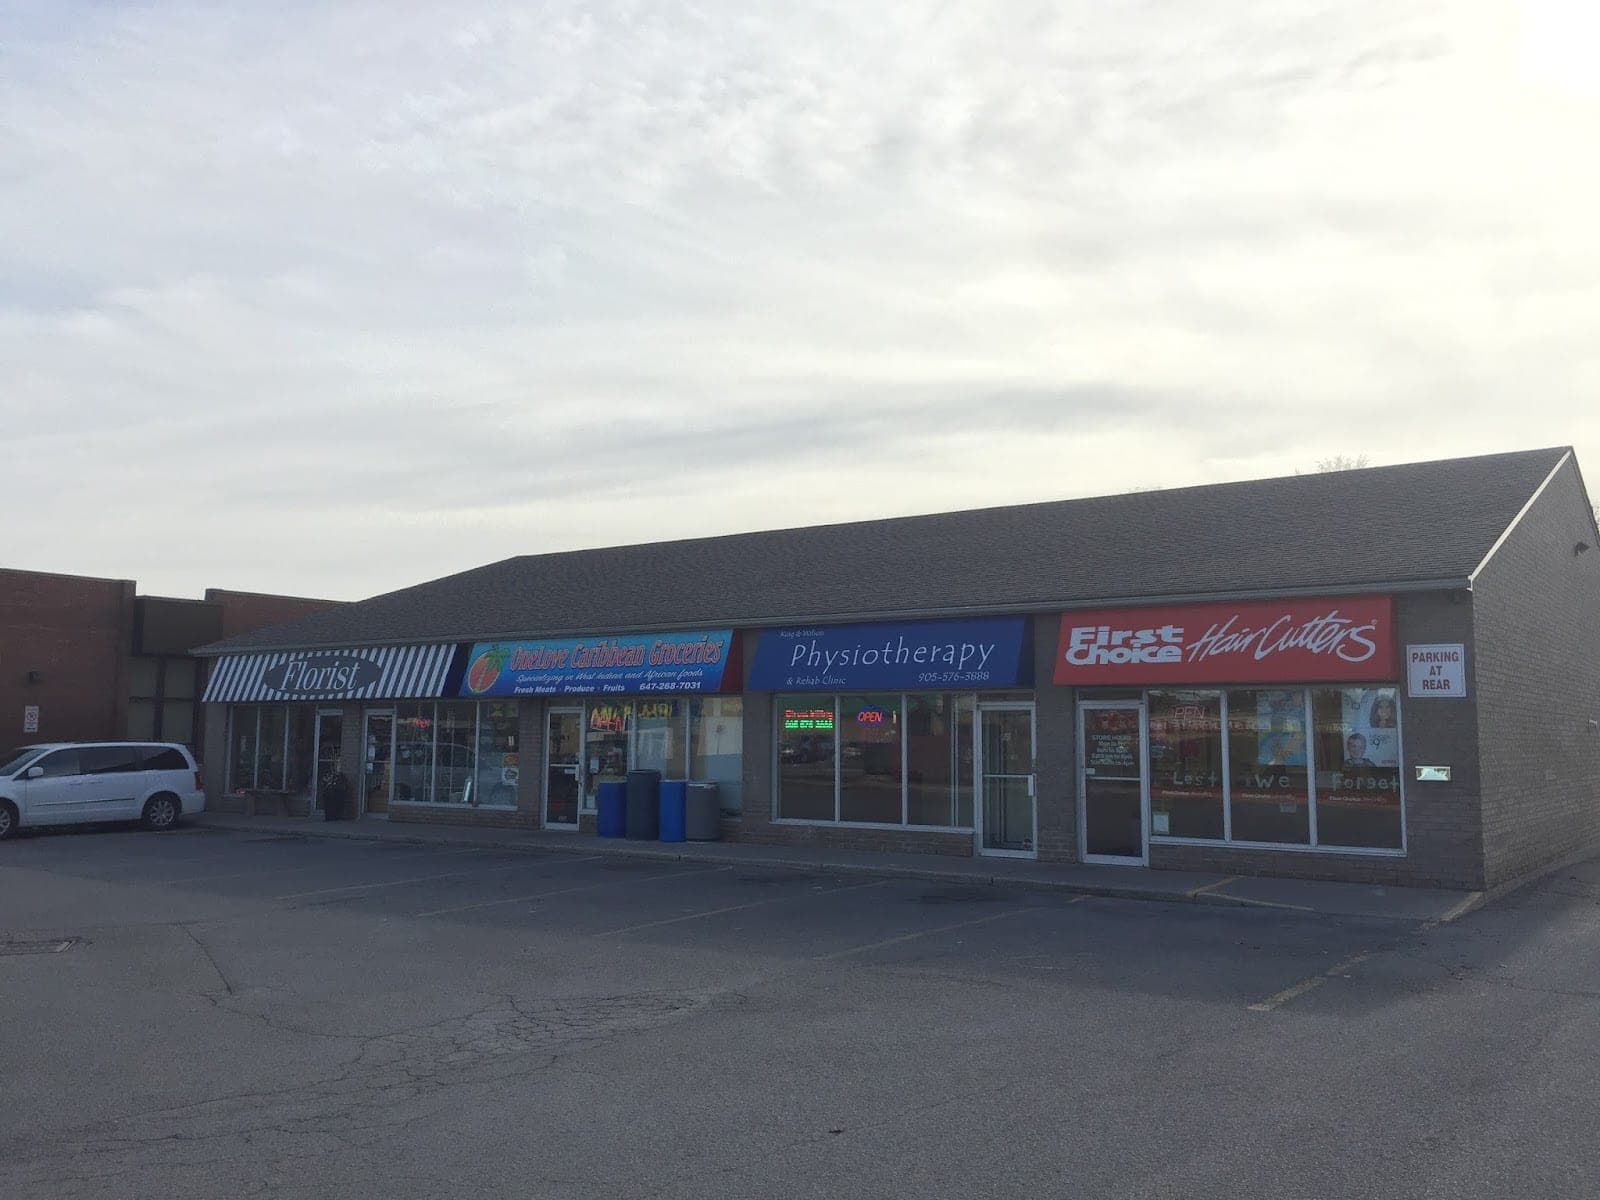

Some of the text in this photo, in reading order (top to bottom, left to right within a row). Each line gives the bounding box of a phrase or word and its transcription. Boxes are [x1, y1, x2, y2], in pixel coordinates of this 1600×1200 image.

[1070, 624, 1184, 646] First
[570, 639, 645, 669] Caribbean
[648, 634, 723, 666] Groceries
[790, 636, 996, 674] Physiotherapy
[1065, 640, 1182, 665] Choice
[1412, 651, 1460, 663] PARKING
[280, 660, 360, 691] Florist
[624, 670, 643, 679] and
[643, 668, 676, 682] African
[675, 667, 704, 681] foods
[918, 671, 991, 682] 905-576-3888
[1429, 665, 1443, 676] AT
[786, 675, 847, 686] & Rehab Clinic
[1422, 679, 1451, 690] REAR
[513, 683, 625, 694] Fresh Meats Produce Fruits
[857, 711, 883, 722] OPEN
[1172, 770, 1217, 788] Lest
[1331, 772, 1400, 793] Forget
